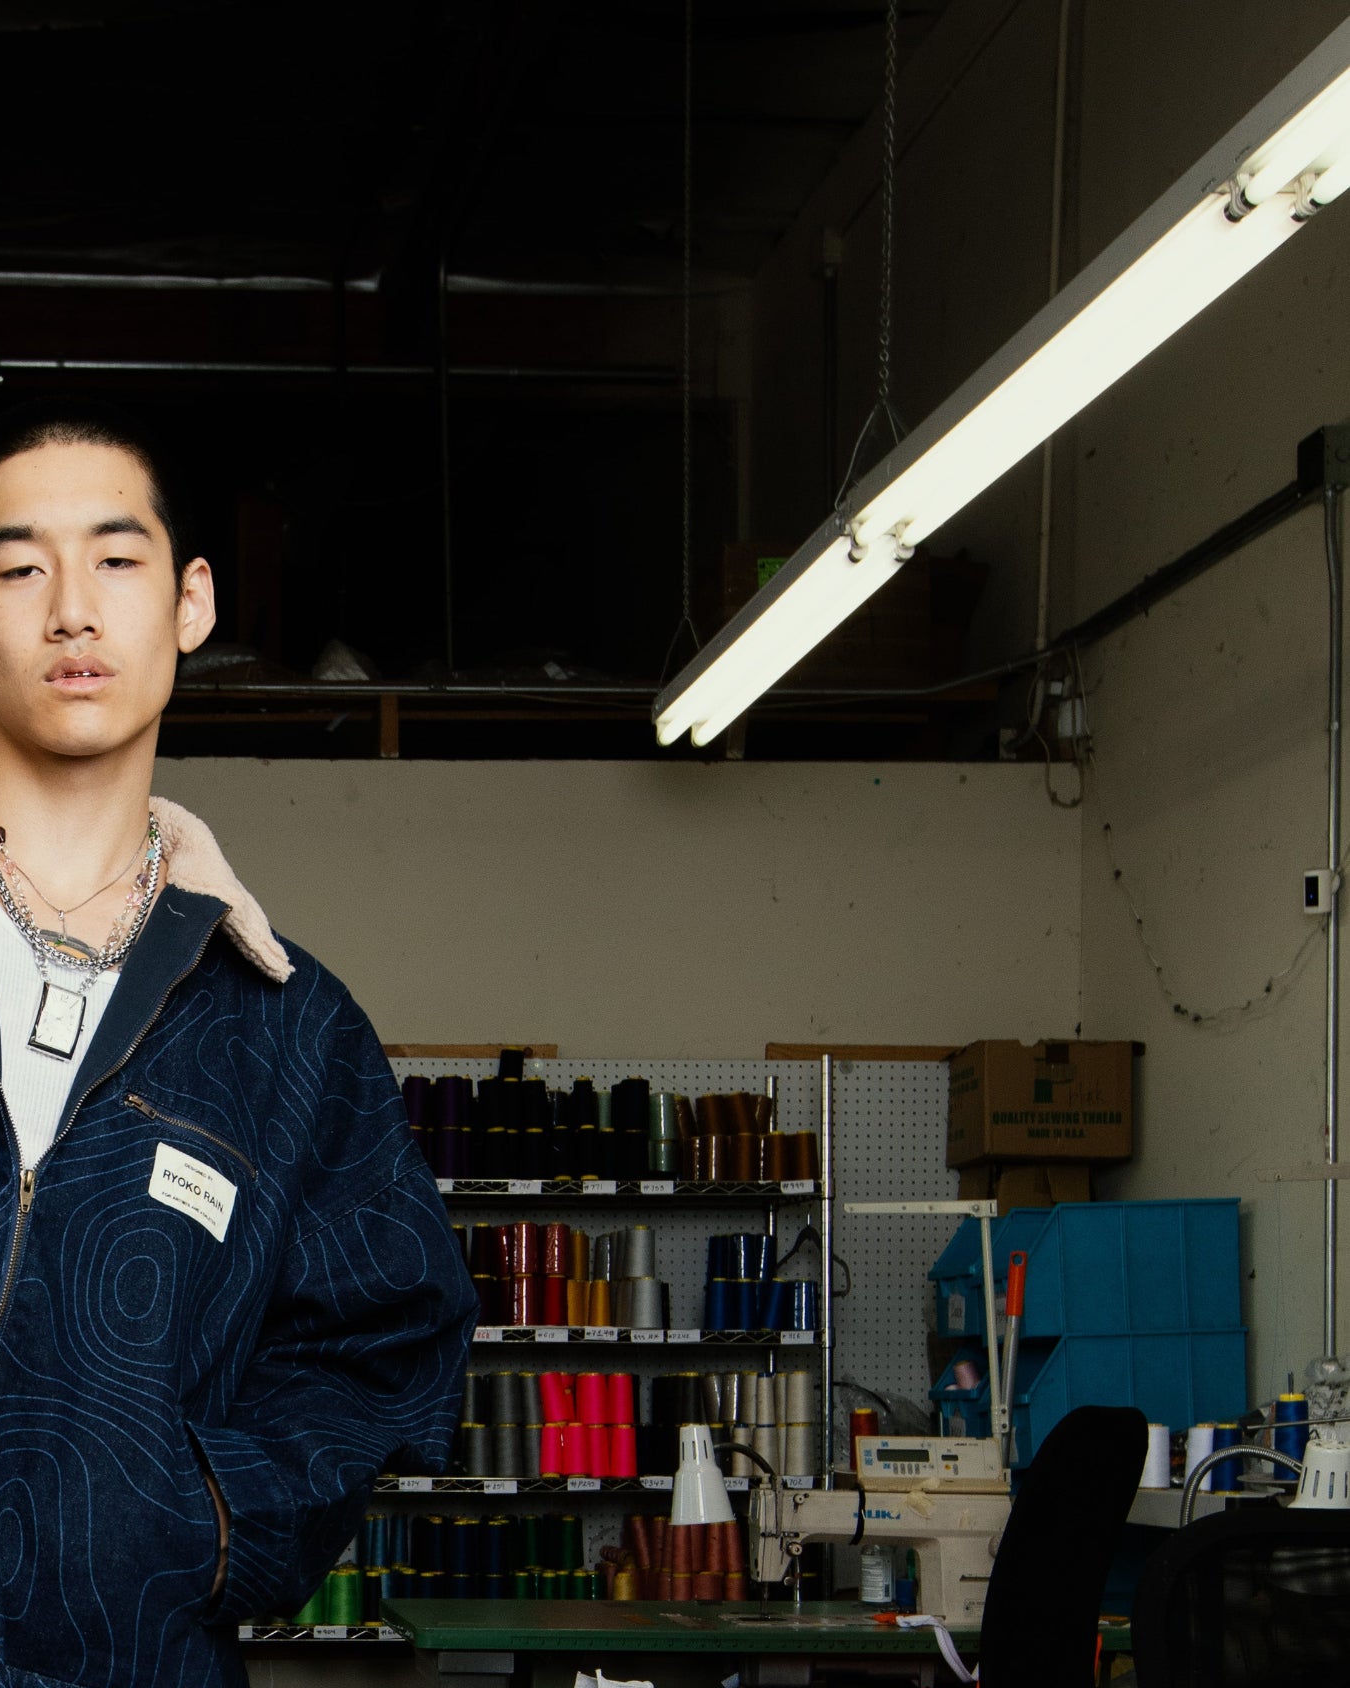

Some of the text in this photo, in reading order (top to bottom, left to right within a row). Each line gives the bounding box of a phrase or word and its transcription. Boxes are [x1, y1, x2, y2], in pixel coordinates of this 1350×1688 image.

[992, 1111, 1122, 1125] QUALITY SEWING THREAD
[162, 1169, 202, 1196] RYOKO
